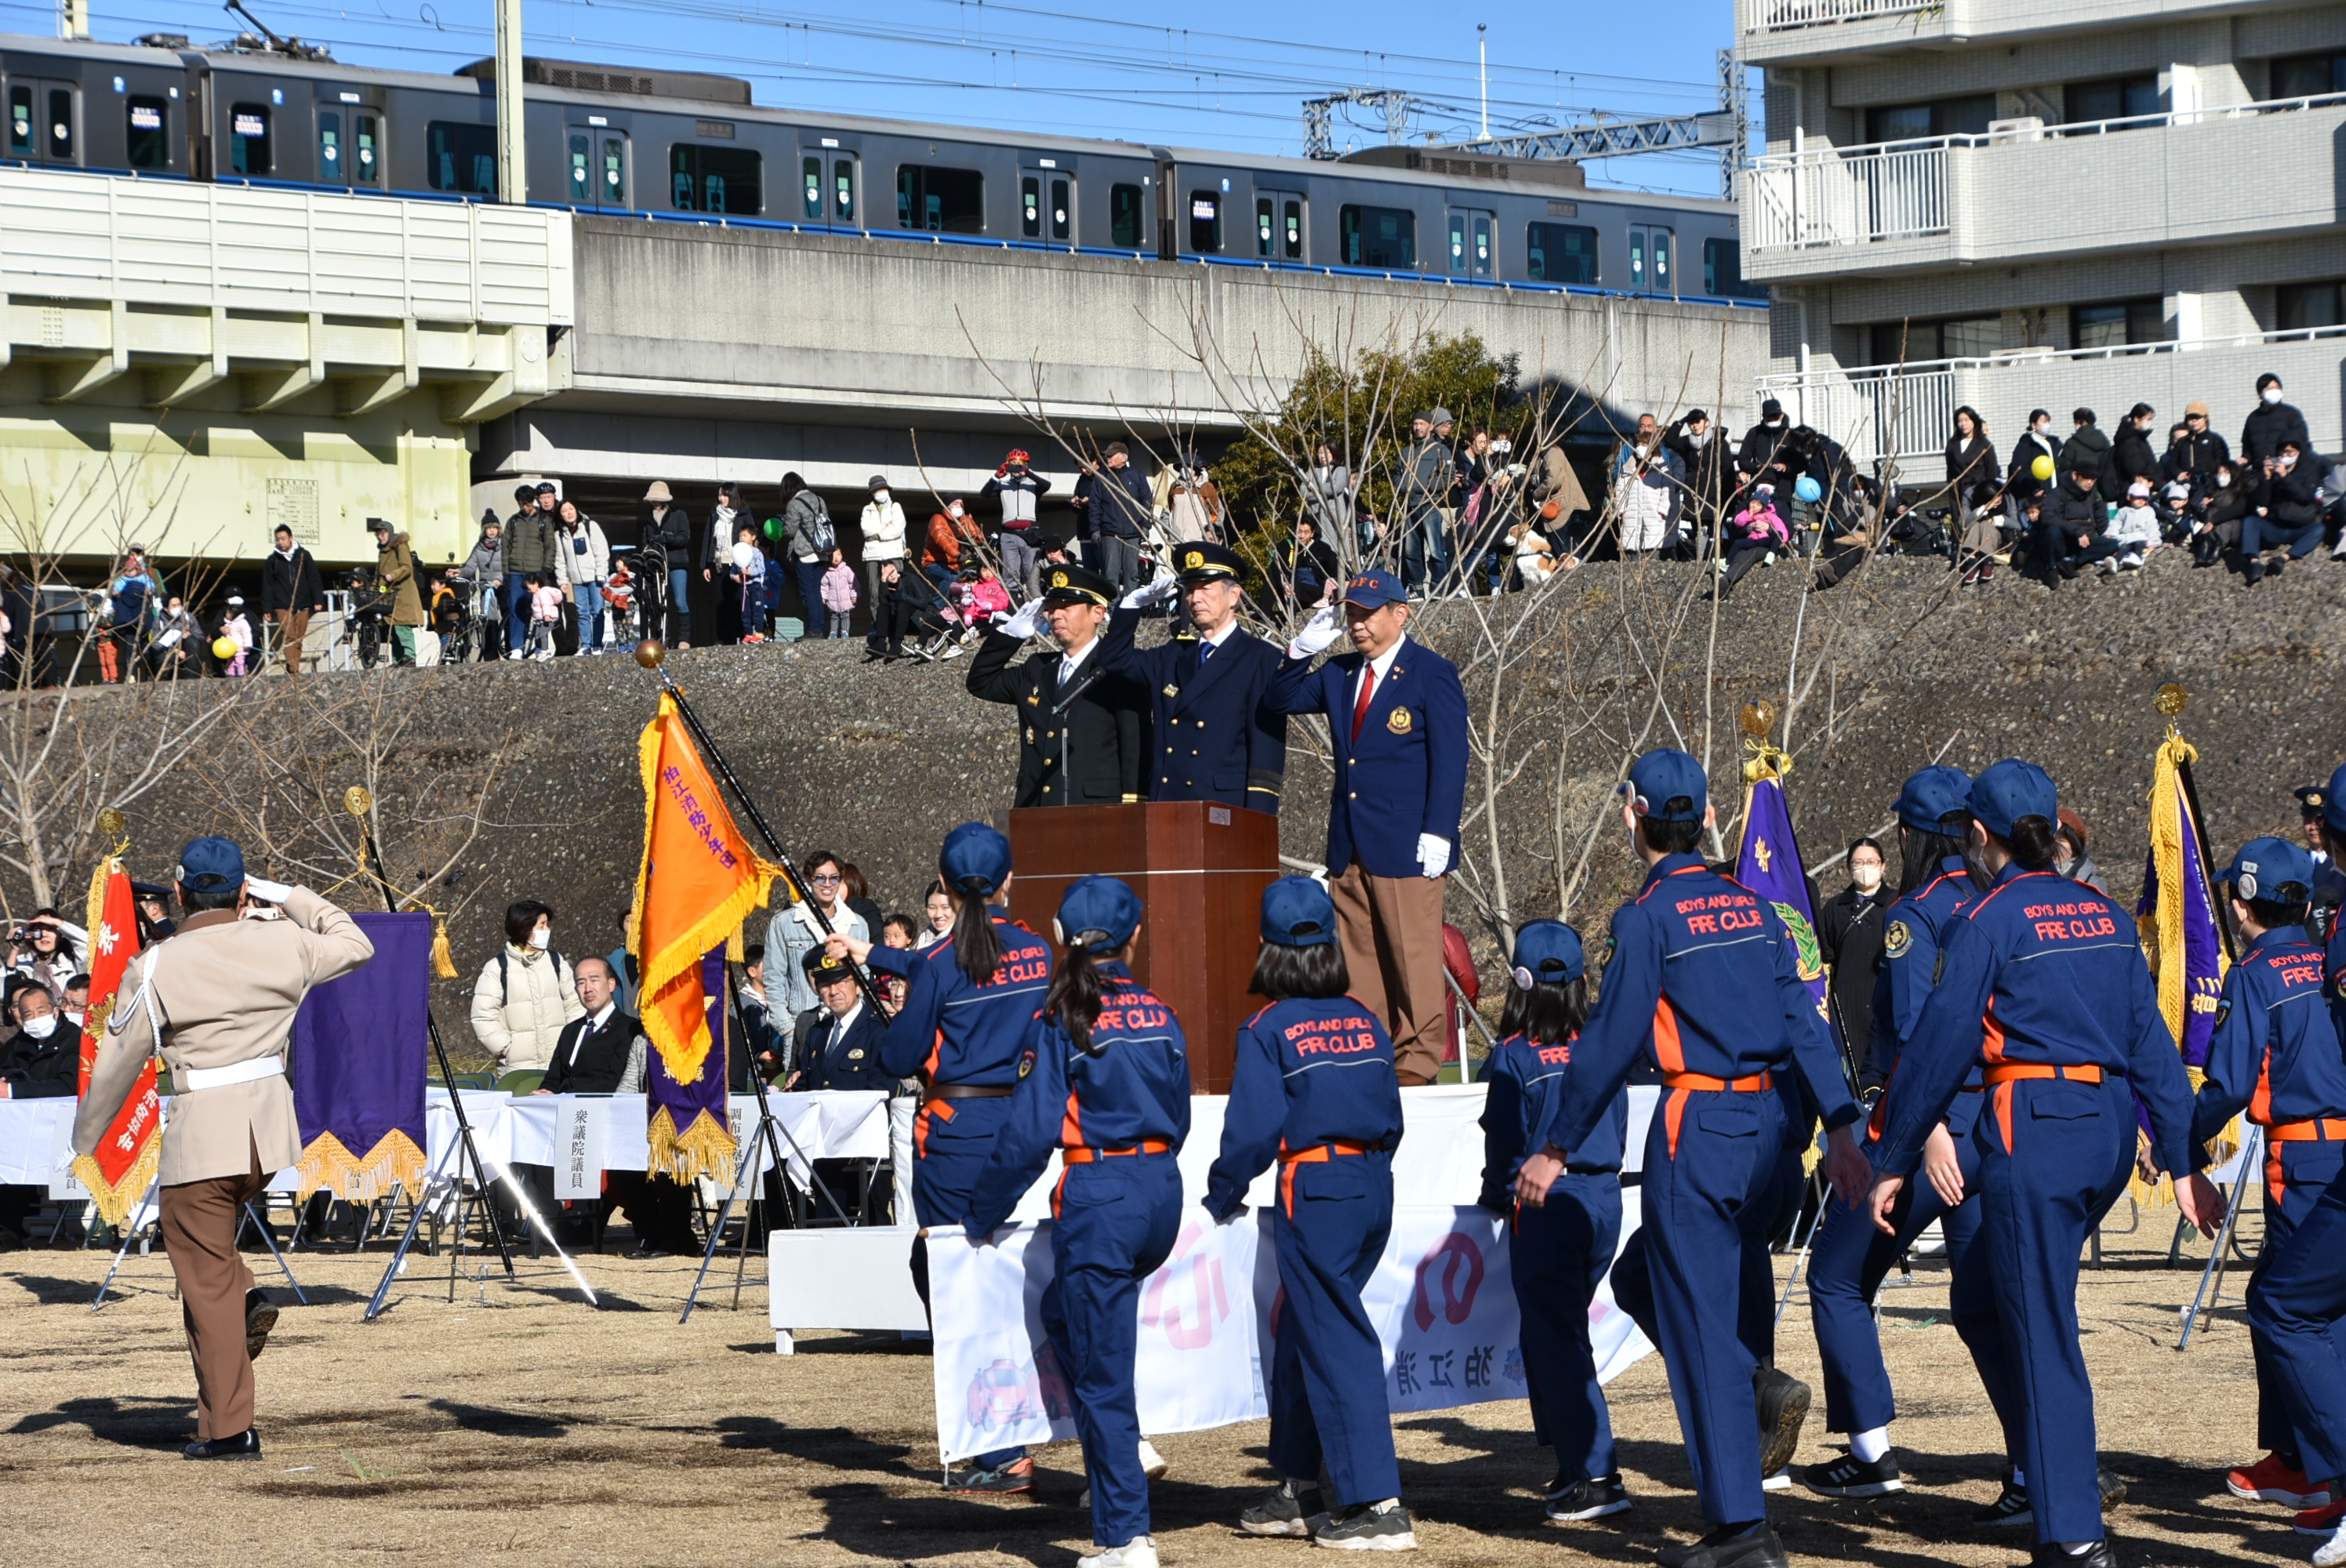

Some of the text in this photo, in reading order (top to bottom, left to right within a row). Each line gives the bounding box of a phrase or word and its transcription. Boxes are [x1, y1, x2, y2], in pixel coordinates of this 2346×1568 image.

[663, 766, 737, 869] 狛江消防少年団
[1675, 897, 1706, 914] BOYS
[1708, 895, 1732, 909] AND
[2024, 902, 2109, 919] BOYS AND GIRLS
[1687, 909, 1763, 935] FIRE CLUB
[2035, 917, 2116, 942] FIRE CLUB
[1010, 960, 1048, 982] CLUB
[2268, 953, 2323, 968] BOYS AND
[2281, 966, 2319, 988] FIRE
[1284, 1017, 1374, 1041] BOYS AND GIRLS
[1295, 1033, 1377, 1058] FIRE CLUB
[1538, 1046, 1571, 1065] FIRE
[571, 1109, 589, 1189] 衆議院議員
